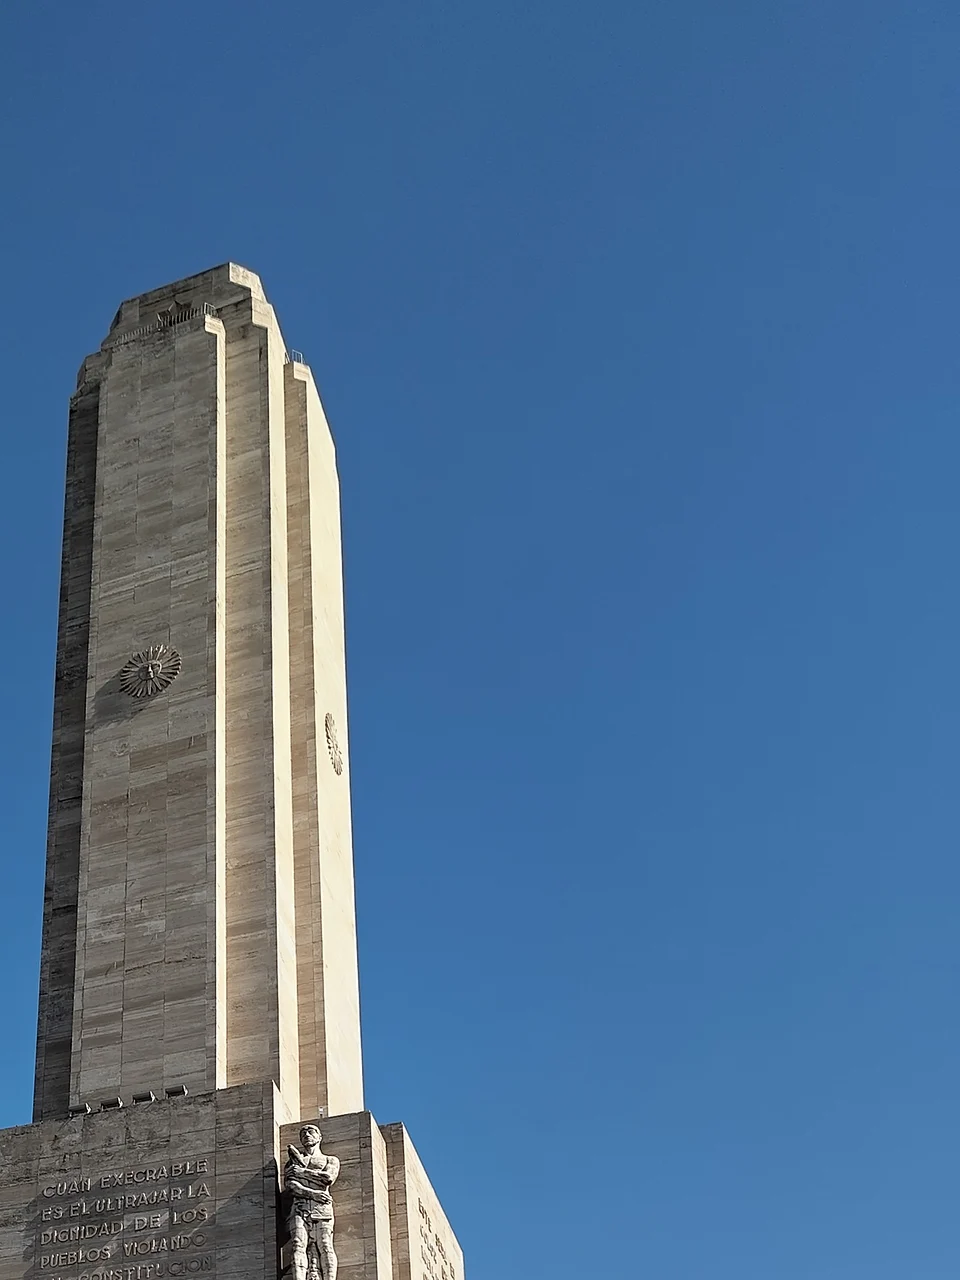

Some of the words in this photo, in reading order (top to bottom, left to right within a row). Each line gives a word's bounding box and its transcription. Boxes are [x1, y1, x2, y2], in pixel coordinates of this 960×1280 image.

[43, 1178, 91, 1198] CUAN
[100, 1159, 208, 1189] EXECRABLE
[42, 1206, 63, 1221] ES
[70, 1202, 90, 1217] EL
[96, 1186, 184, 1213] ULTRAJAR
[188, 1183, 211, 1198] LA
[40, 1221, 124, 1245] DIGNIDAD
[134, 1213, 161, 1232] DE
[172, 1208, 208, 1225] LOS
[40, 1246, 110, 1269] PUEBLOS
[124, 1233, 207, 1257] VIOLANDO
